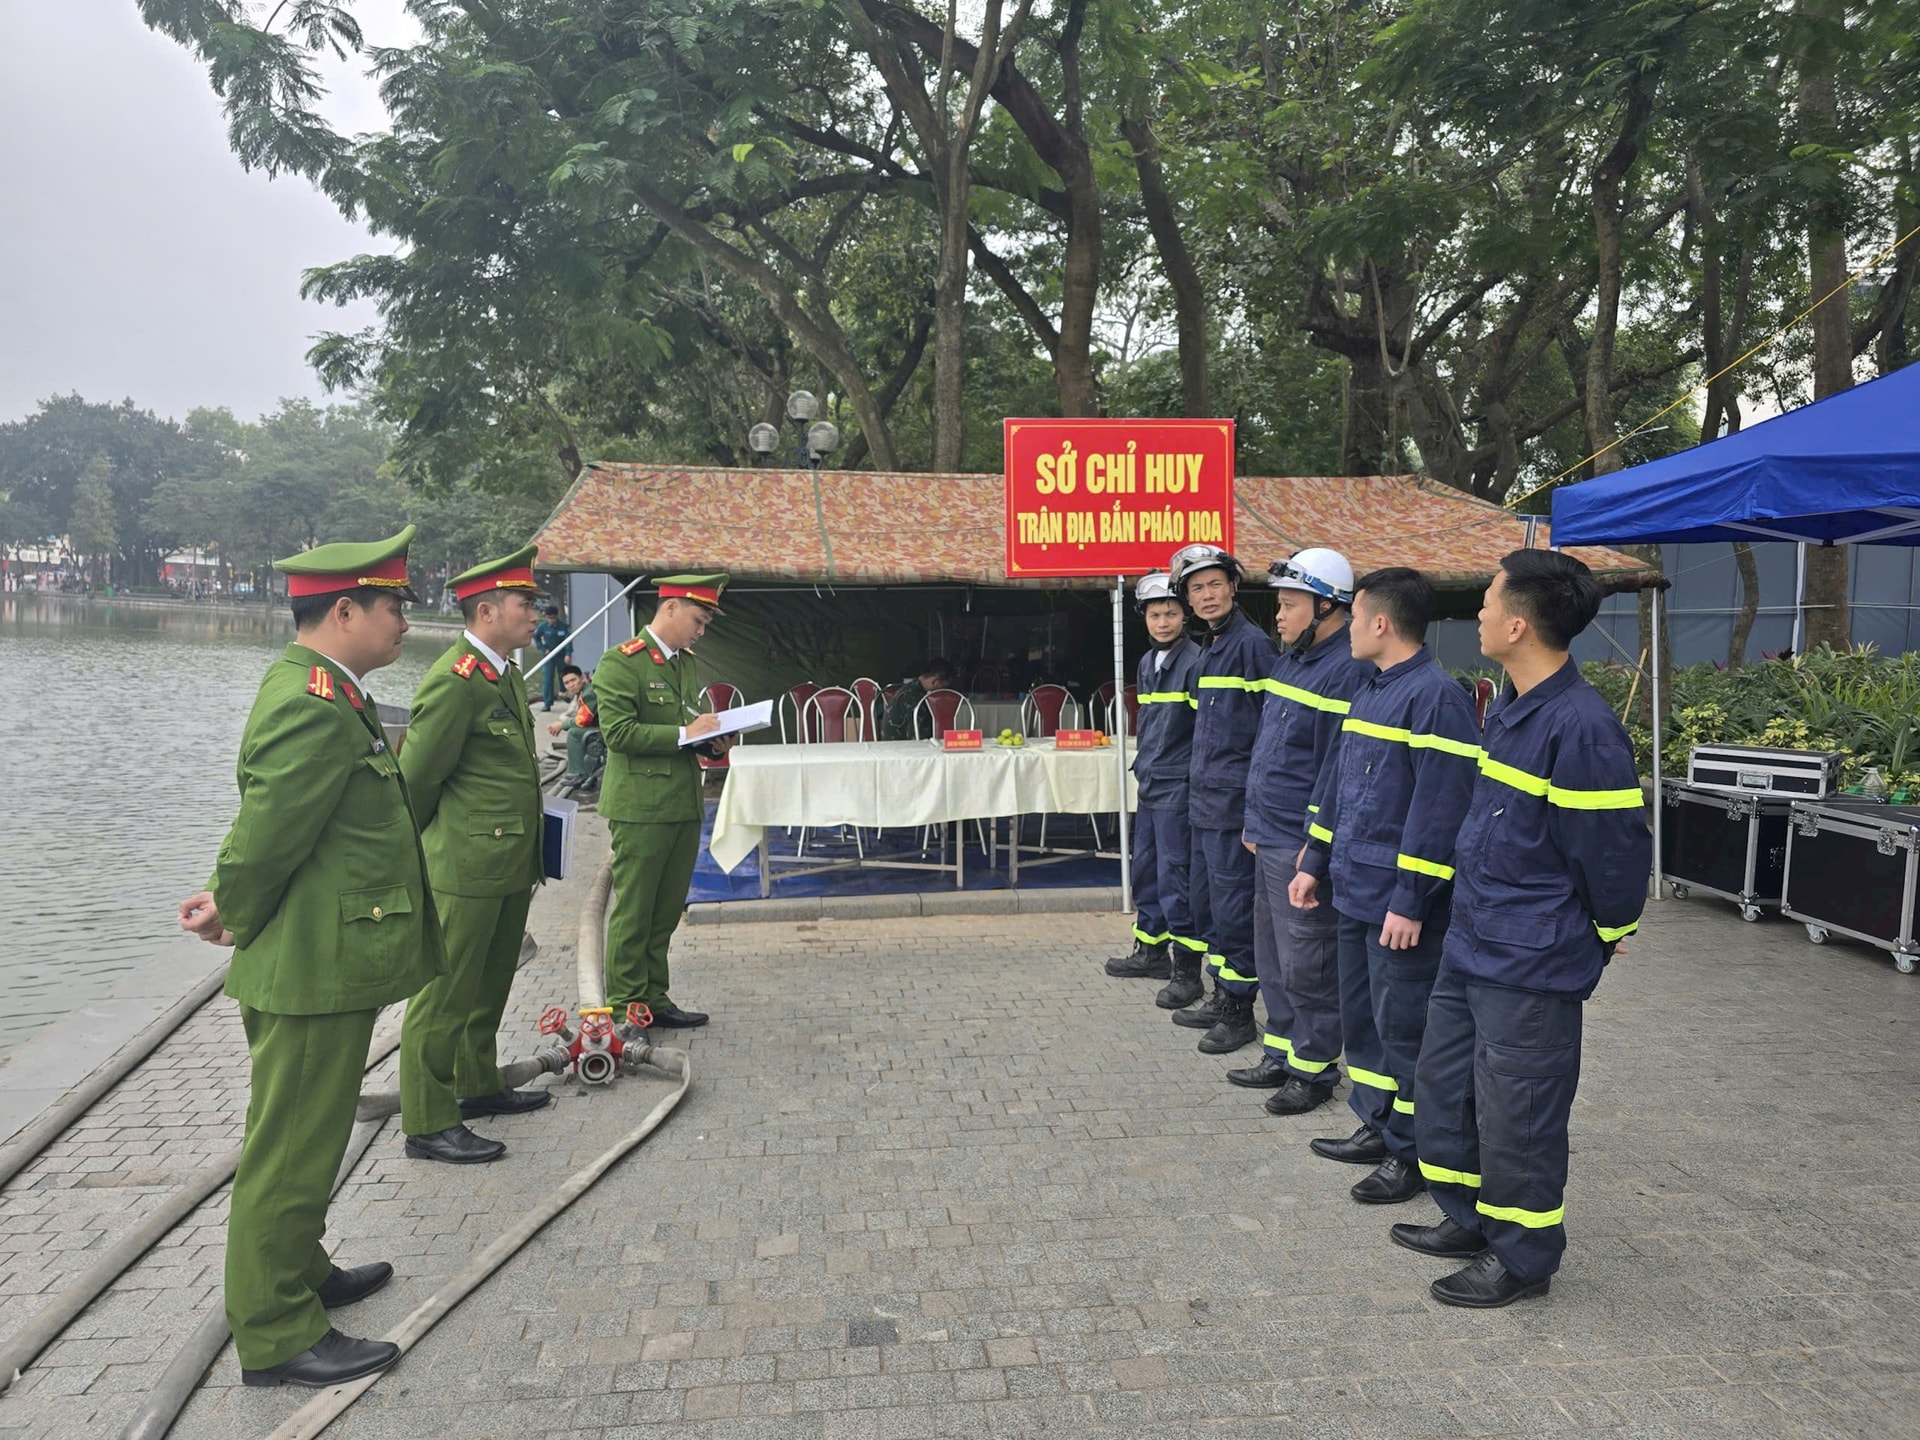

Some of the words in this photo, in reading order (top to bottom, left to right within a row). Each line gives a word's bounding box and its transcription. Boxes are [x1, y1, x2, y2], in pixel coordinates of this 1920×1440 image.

[1036, 440, 1078, 495] SỞ
[1085, 440, 1137, 494] CHỈ
[1145, 453, 1204, 494] HUY
[1016, 505, 1063, 551] TRẬN
[1066, 511, 1097, 551] ĐỊA
[1099, 499, 1136, 544] BẮN
[1139, 504, 1185, 543] PHÁO
[1188, 510, 1223, 543] HOA
